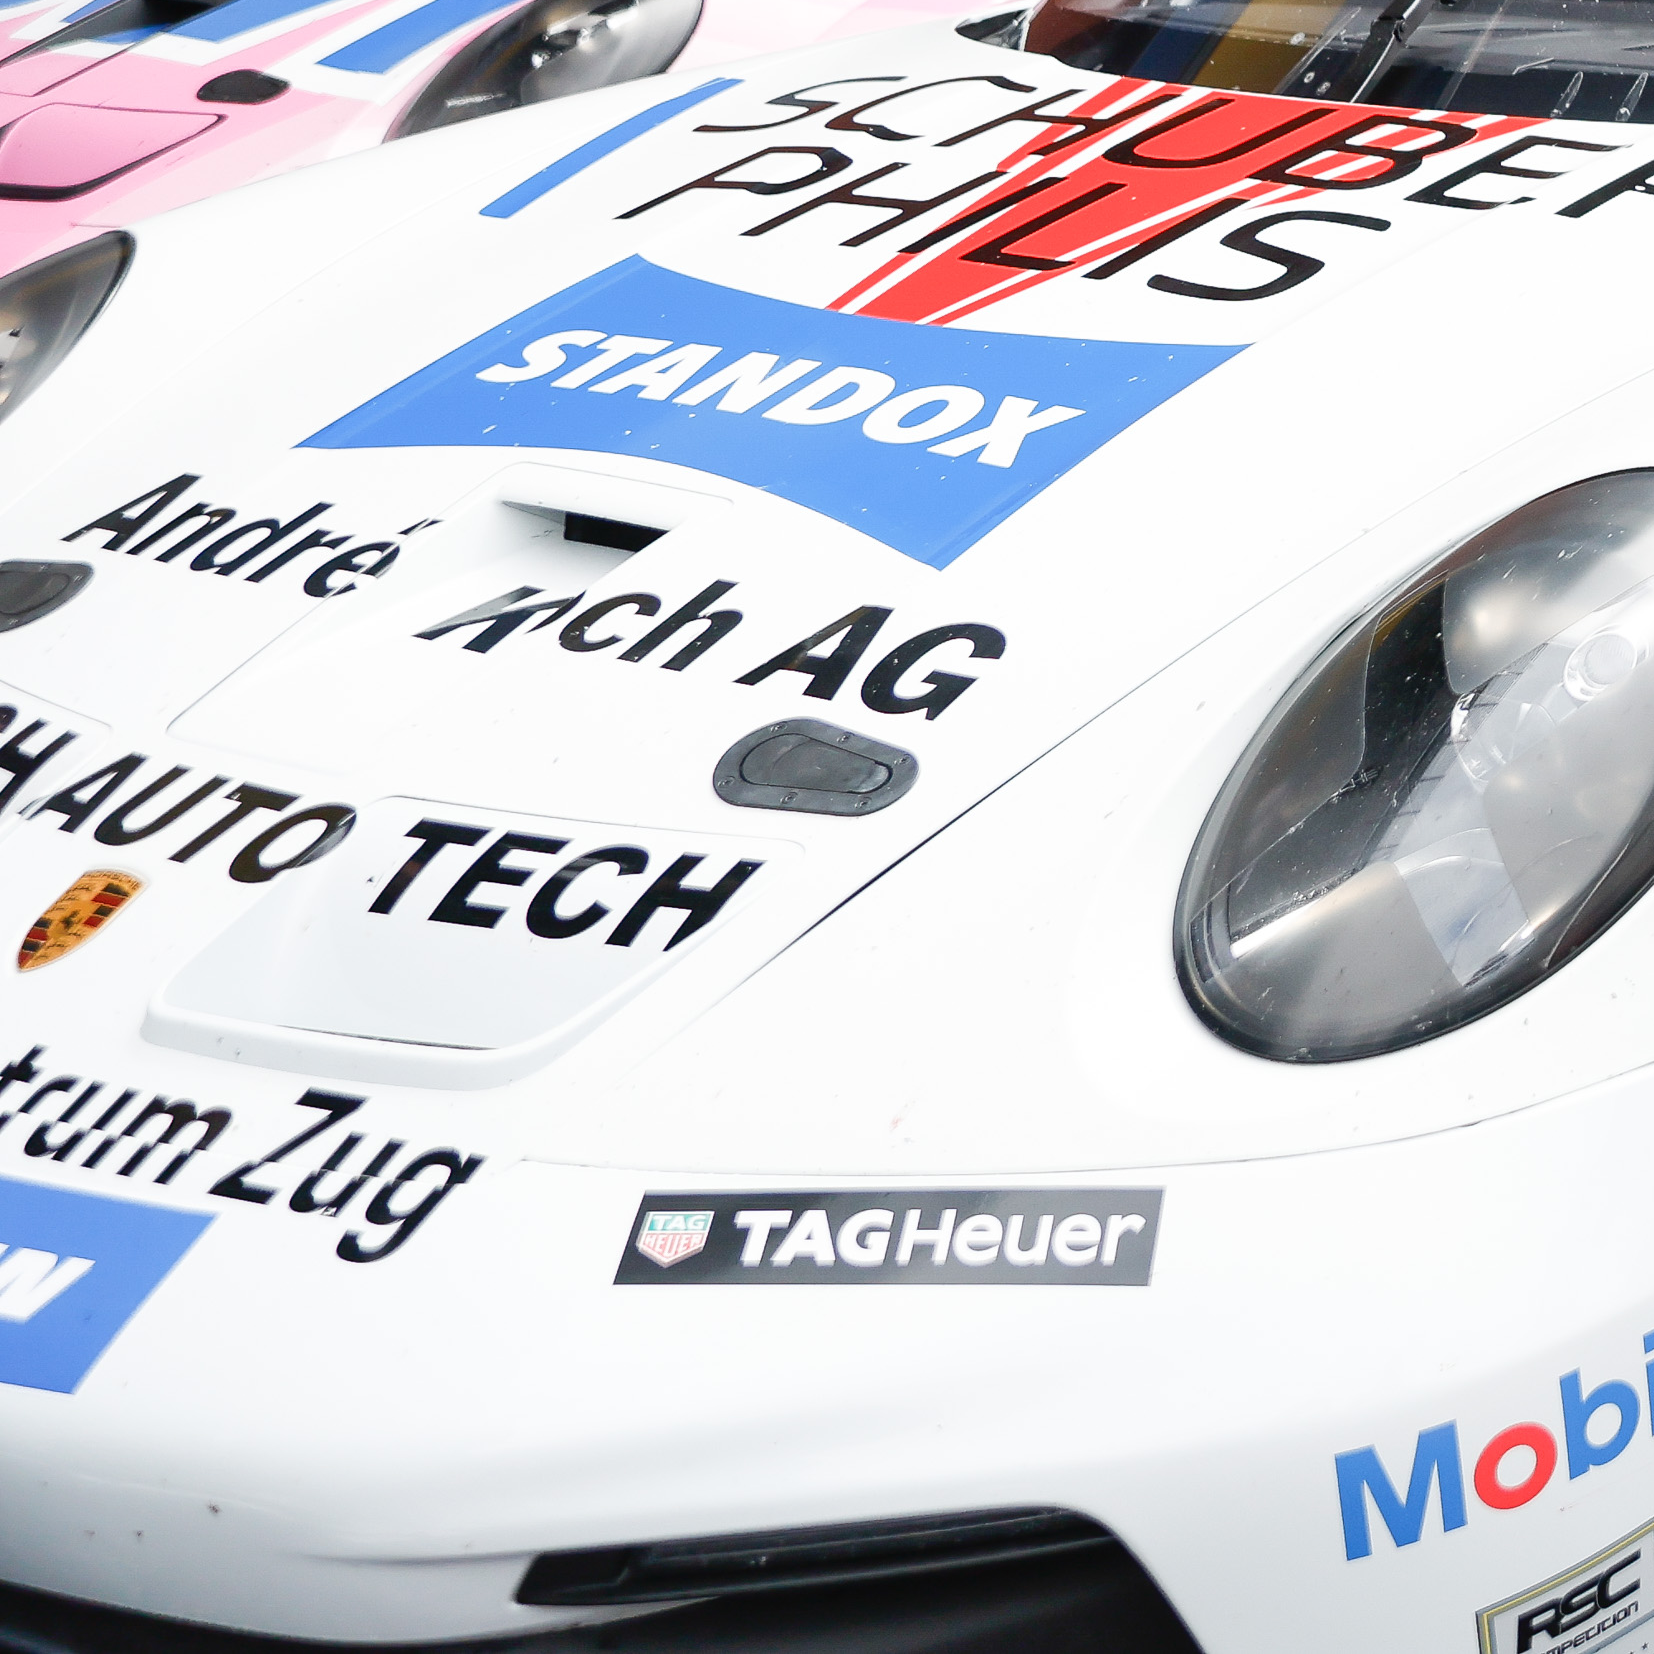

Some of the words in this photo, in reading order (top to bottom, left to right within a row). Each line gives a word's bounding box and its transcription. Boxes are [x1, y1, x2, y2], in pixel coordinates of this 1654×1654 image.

[613, 145, 1392, 302] PHILIS
[475, 327, 1087, 469] STANDOX
[733, 603, 1008, 722] AG
[17, 751, 358, 883] AUTO
[367, 816, 766, 951] TECH
[0, 1044, 234, 1185] trum
[206, 1087, 490, 1264] Zug
[651, 1214, 708, 1231] TAG
[1516, 1547, 1642, 1654] RSC
